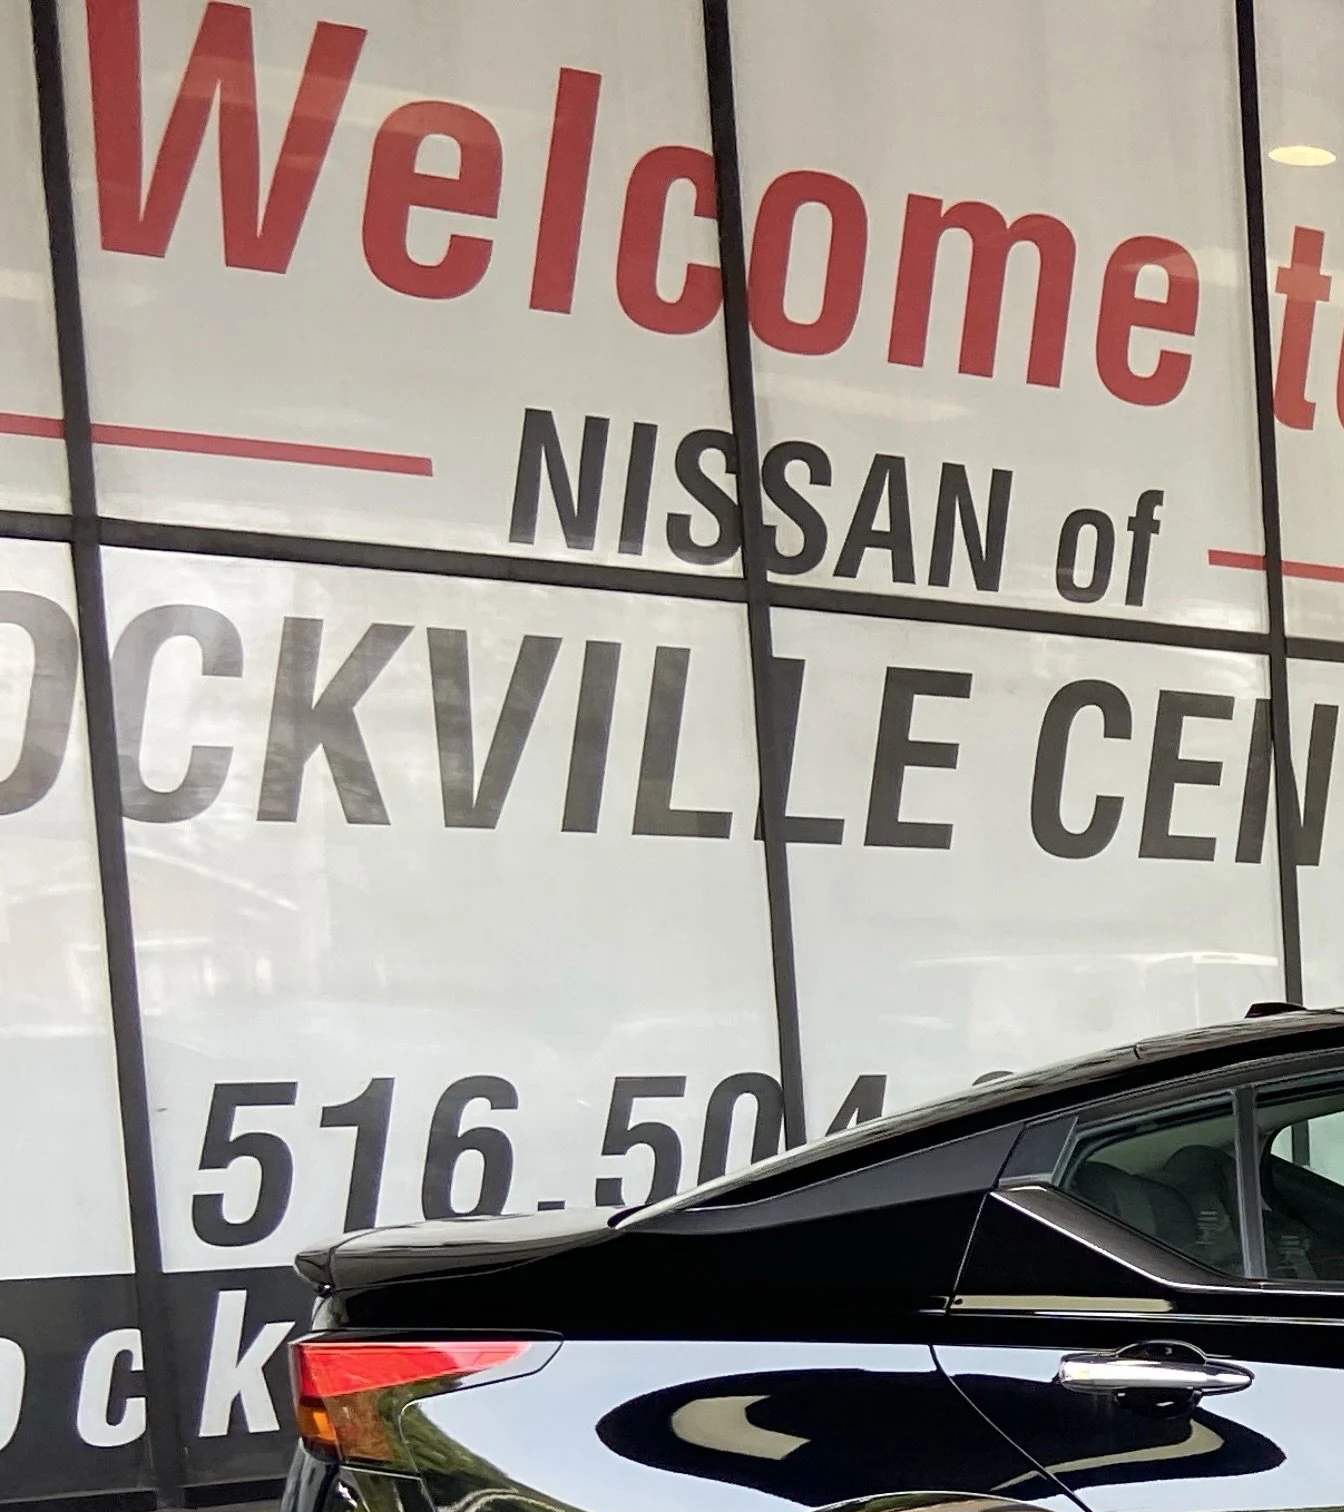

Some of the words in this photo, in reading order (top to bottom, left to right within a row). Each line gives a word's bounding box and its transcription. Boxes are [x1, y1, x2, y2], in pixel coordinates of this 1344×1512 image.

[86, 0, 1200, 407] Welcome
[508, 408, 1013, 594] NISSAN
[1054, 489, 1165, 608] of
